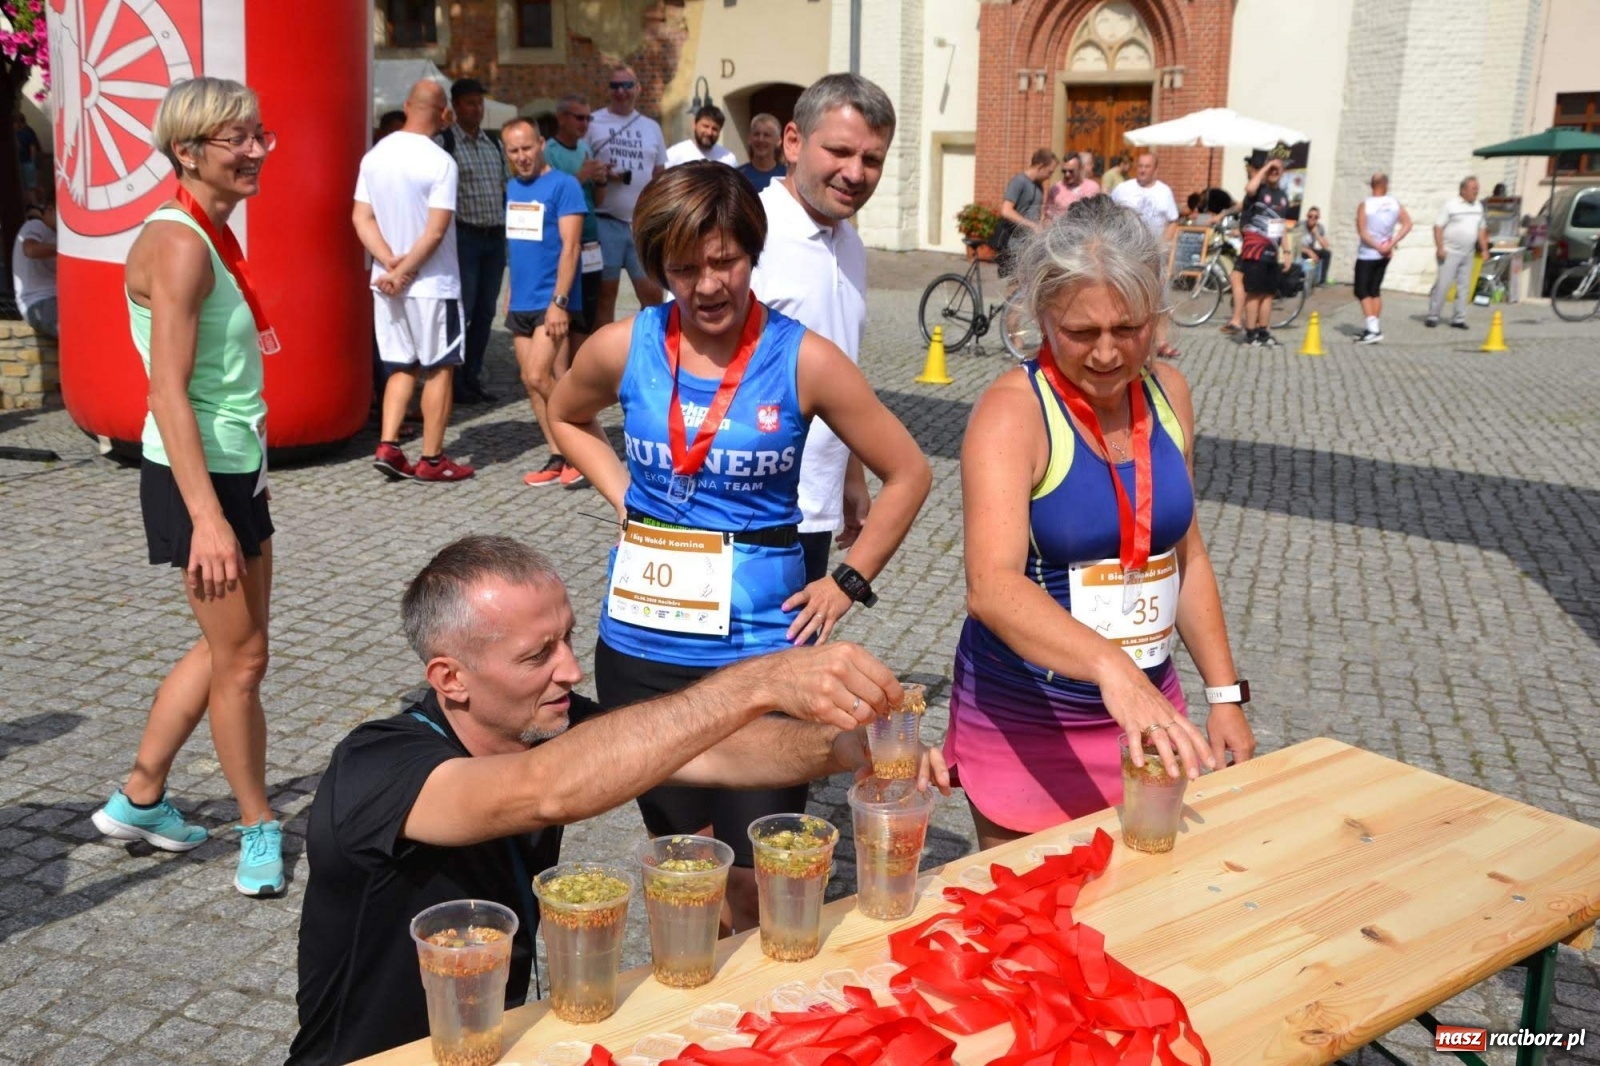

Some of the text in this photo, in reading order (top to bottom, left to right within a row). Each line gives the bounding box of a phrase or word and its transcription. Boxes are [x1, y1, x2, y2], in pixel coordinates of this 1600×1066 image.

[721, 58, 735, 78] D
[610, 147, 644, 159] YNOWA
[723, 481, 764, 491] TEAM
[668, 540, 705, 549] Komina
[642, 561, 673, 588] 40
[1132, 595, 1159, 625] 35
